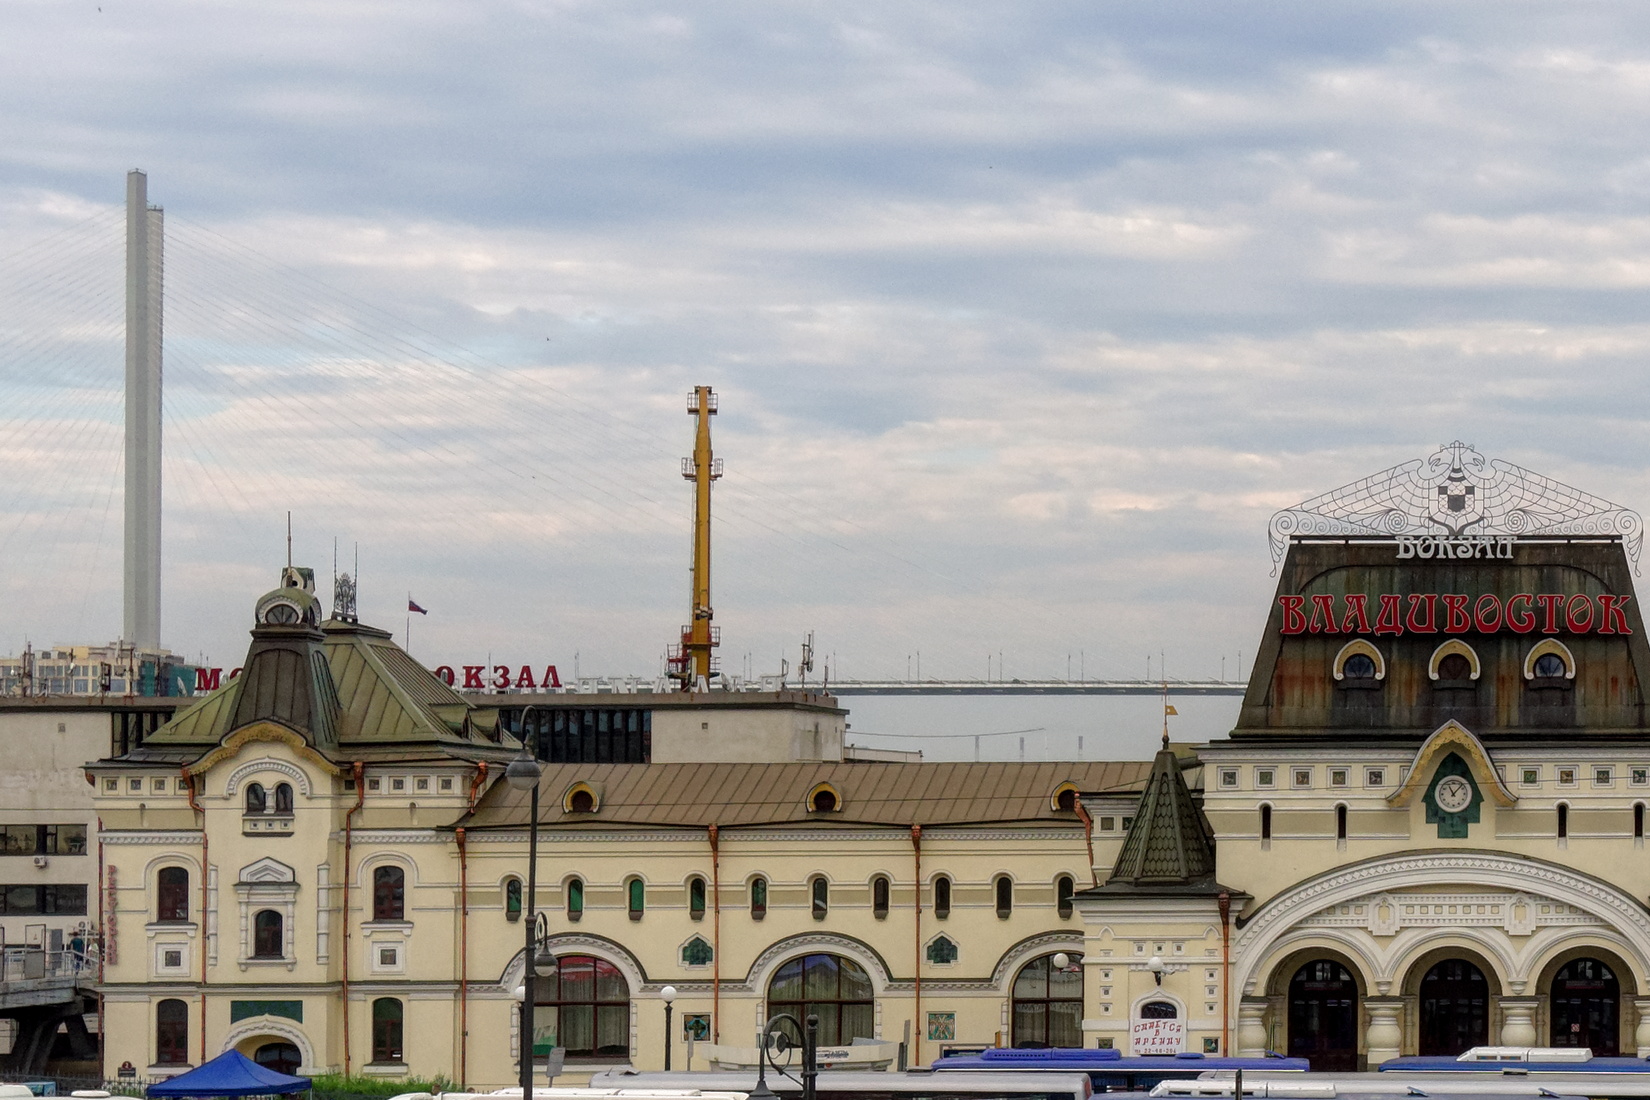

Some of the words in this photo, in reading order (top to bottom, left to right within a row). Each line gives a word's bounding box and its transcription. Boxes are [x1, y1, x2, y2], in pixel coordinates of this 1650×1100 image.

[1395, 535, 1518, 560] ВОКЗАЛ
[1278, 594, 1633, 637] ВЛАДИВОСТОК
[435, 665, 563, 689] ОКЗАЛ
